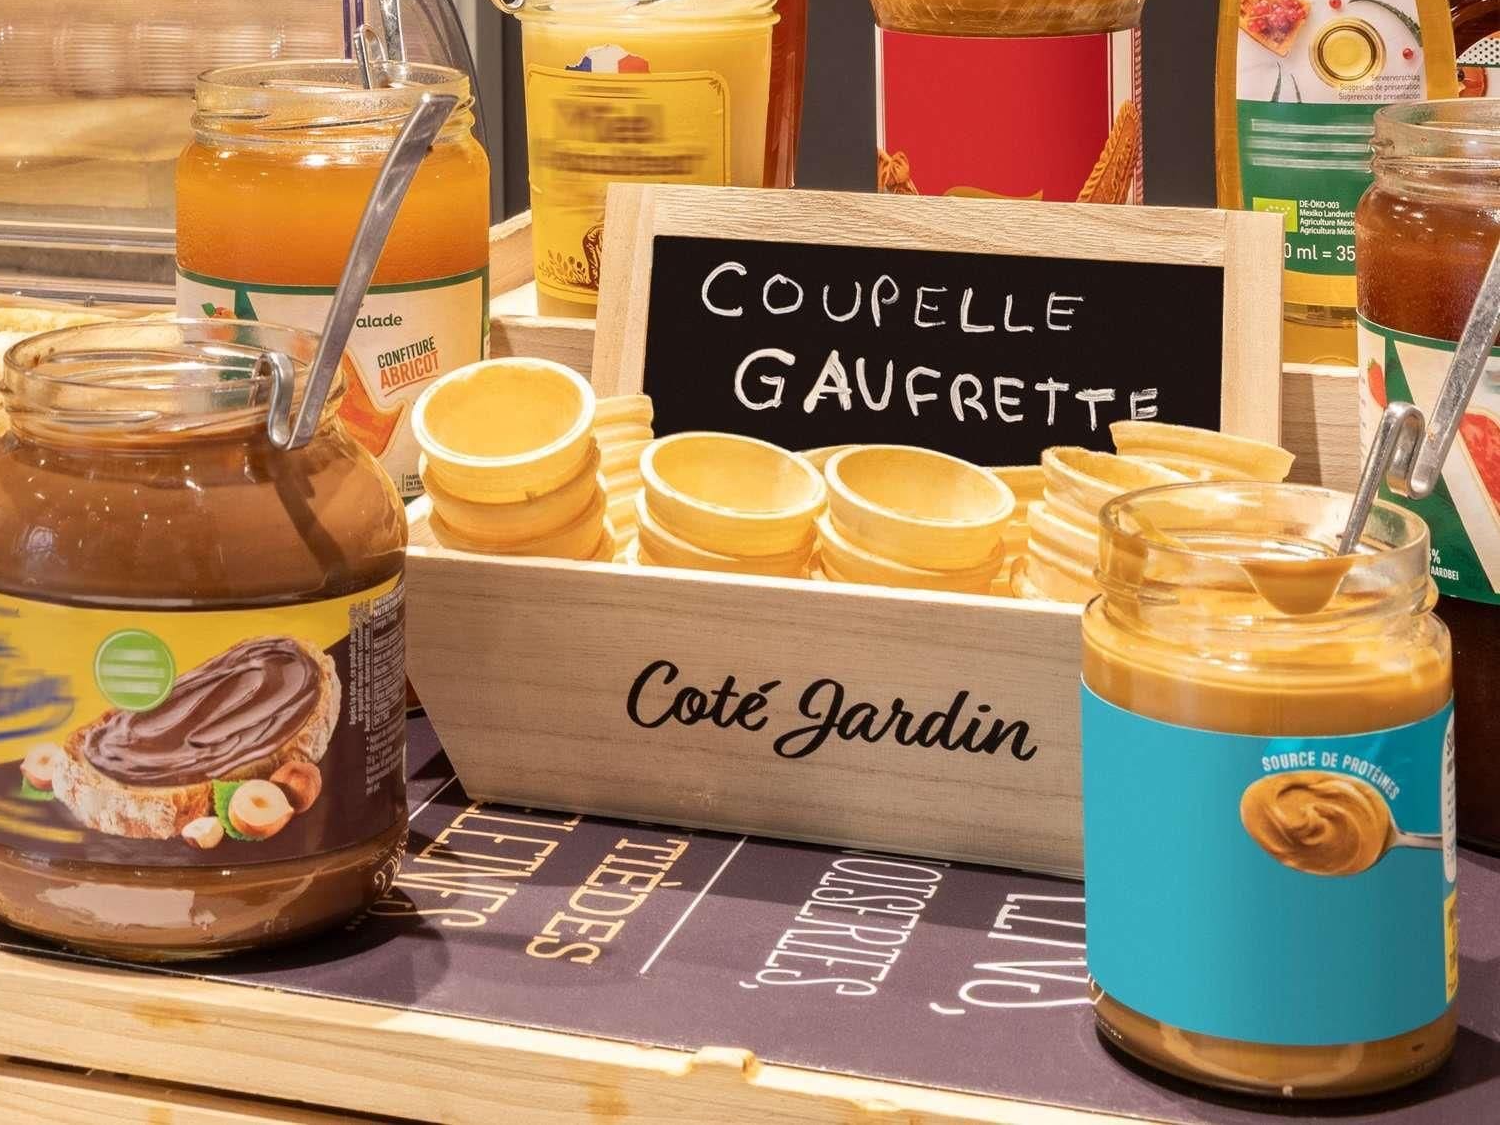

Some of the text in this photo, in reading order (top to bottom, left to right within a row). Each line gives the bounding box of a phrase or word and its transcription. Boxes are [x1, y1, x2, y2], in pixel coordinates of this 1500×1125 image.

[1300, 209, 1323, 217] Mexiko
[1300, 218, 1336, 227] Agriculture
[1300, 227, 1336, 236] Agricultura
[1297, 244, 1318, 260] ml
[700, 261, 1084, 333] COUPELLE
[377, 336, 436, 369] CONFITURE
[380, 350, 440, 389] ABRICOT
[734, 347, 1160, 432] GAUFRETTE
[626, 659, 1038, 762] Coté Jardin
[1261, 751, 1400, 800] SOURCE DE PROTÉINES
[525, 837, 691, 966] TIÈDES
